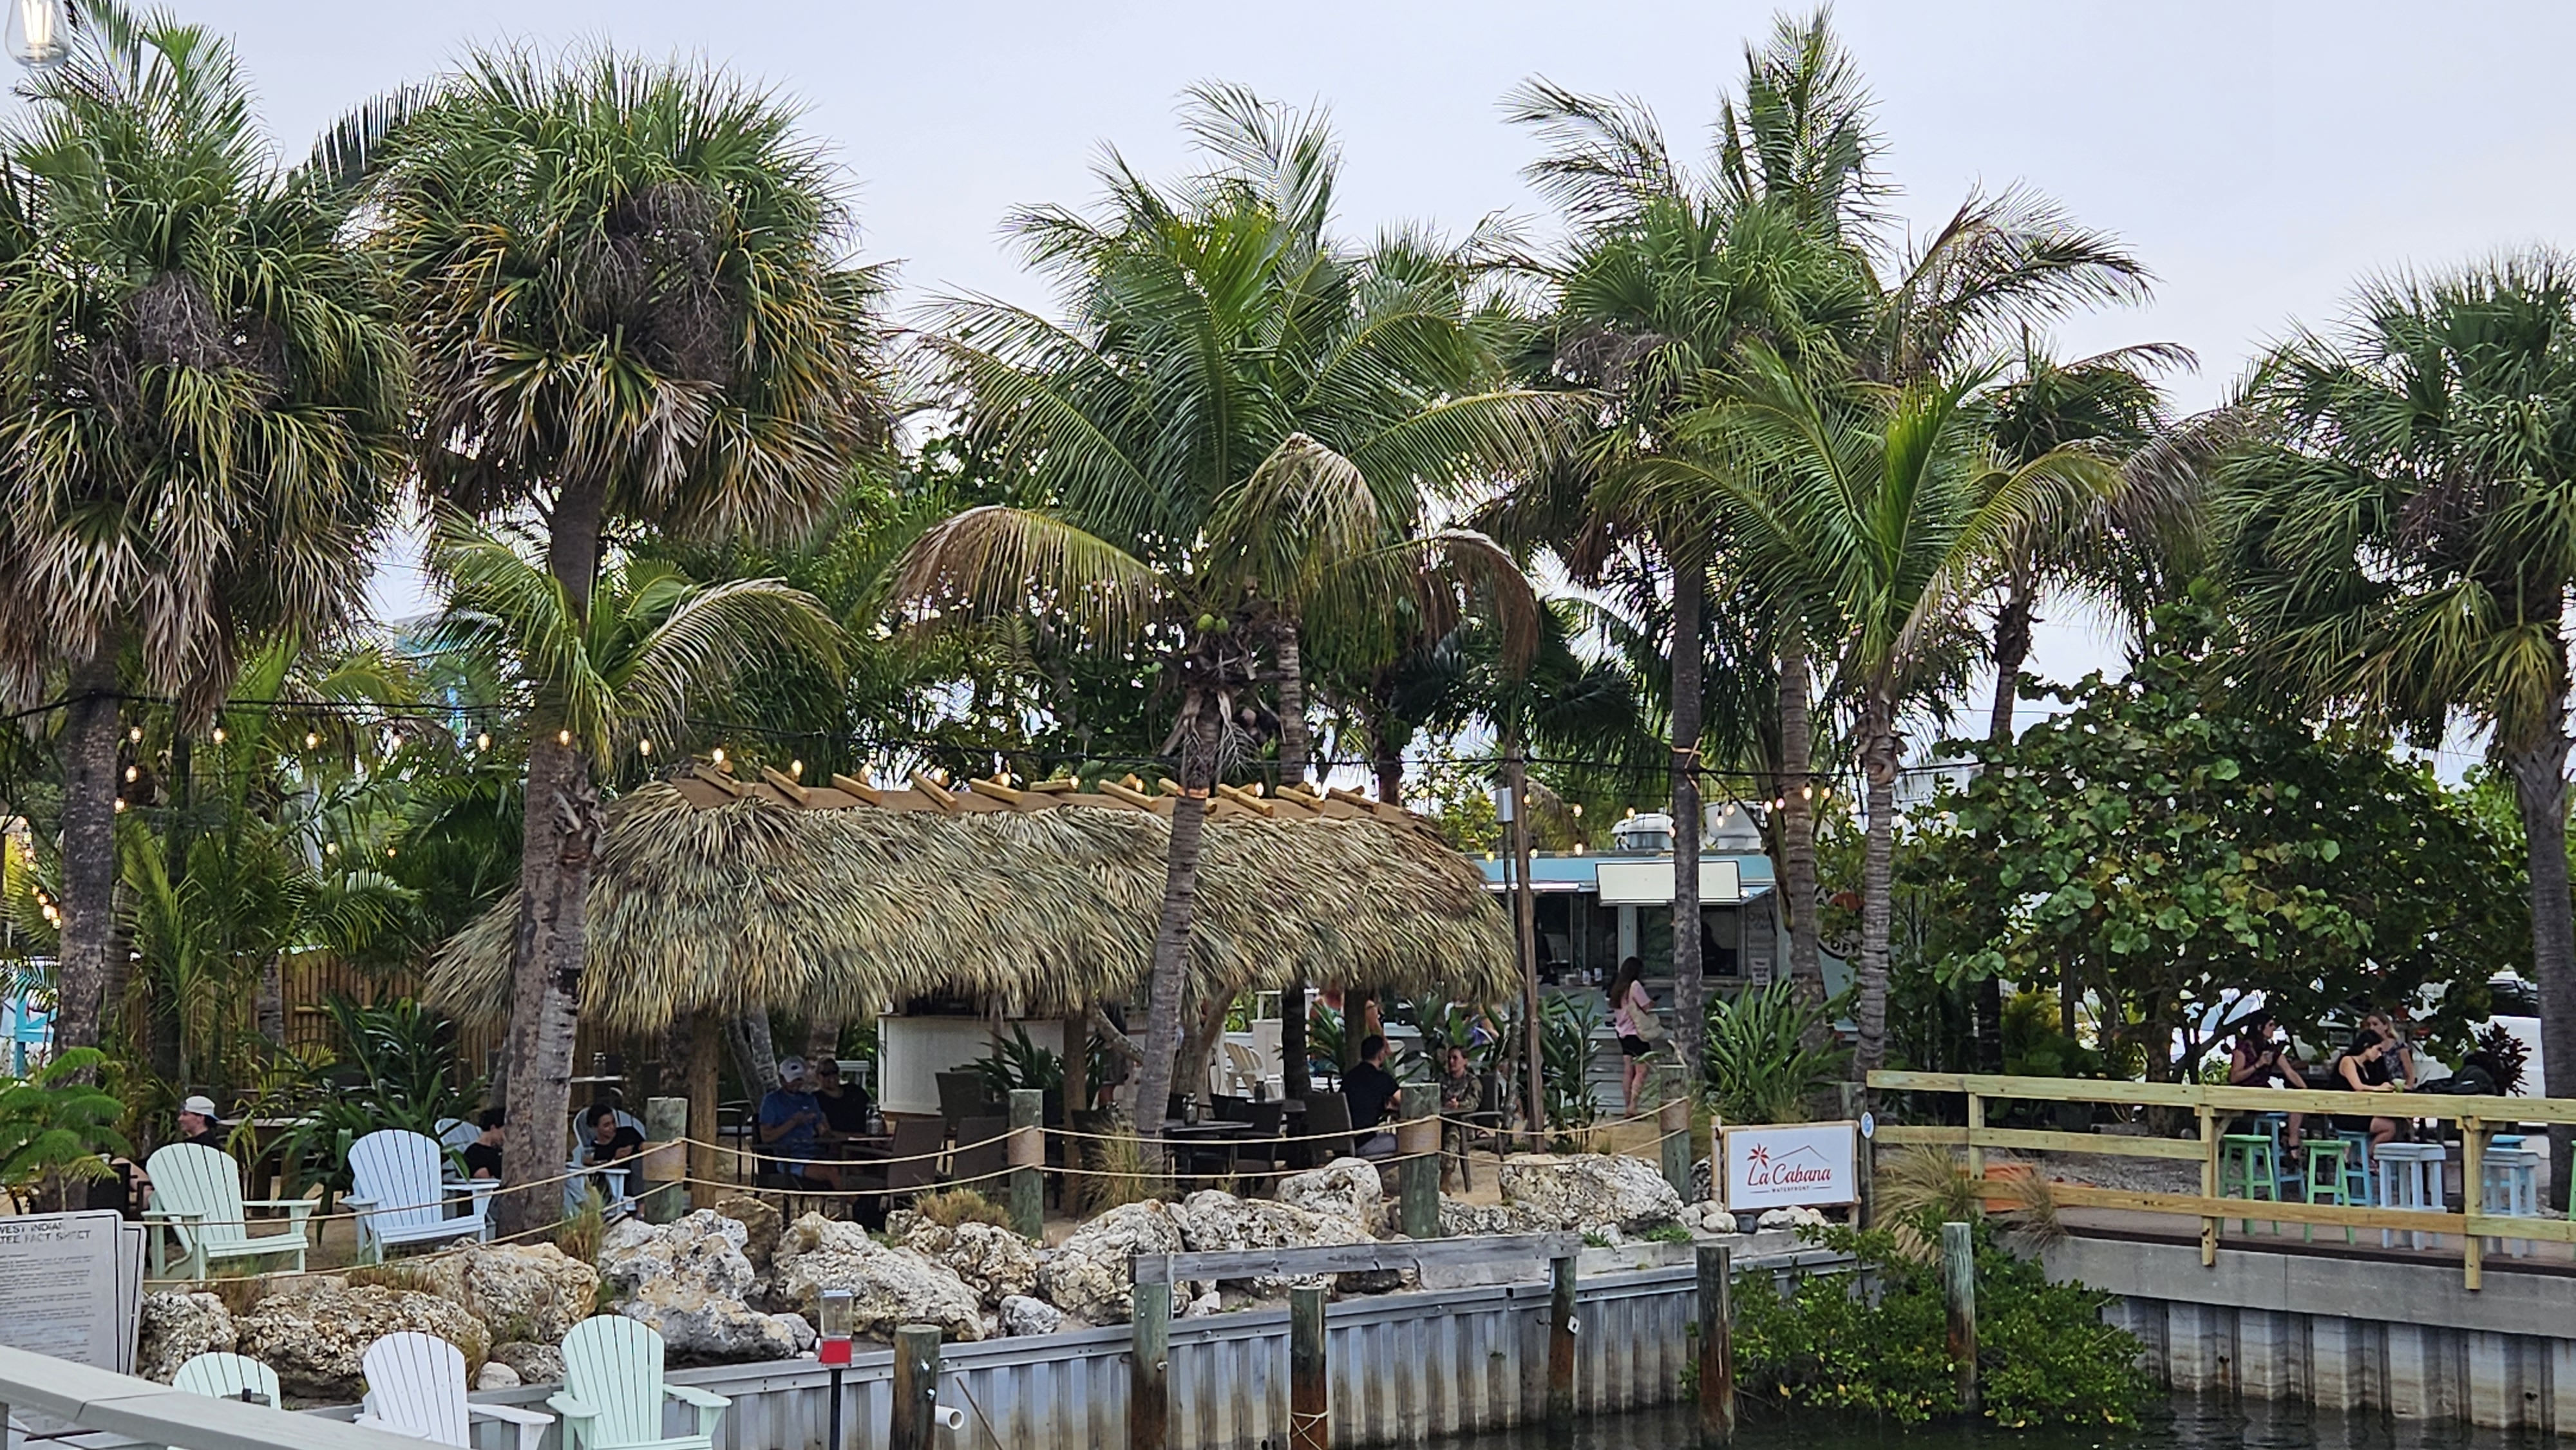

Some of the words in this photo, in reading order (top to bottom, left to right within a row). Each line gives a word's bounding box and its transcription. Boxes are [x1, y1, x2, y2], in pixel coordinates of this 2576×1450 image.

[1747, 1159, 1770, 1186] La
[1772, 1163, 1832, 1185] Cabana
[0, 1235, 21, 1244] TEE
